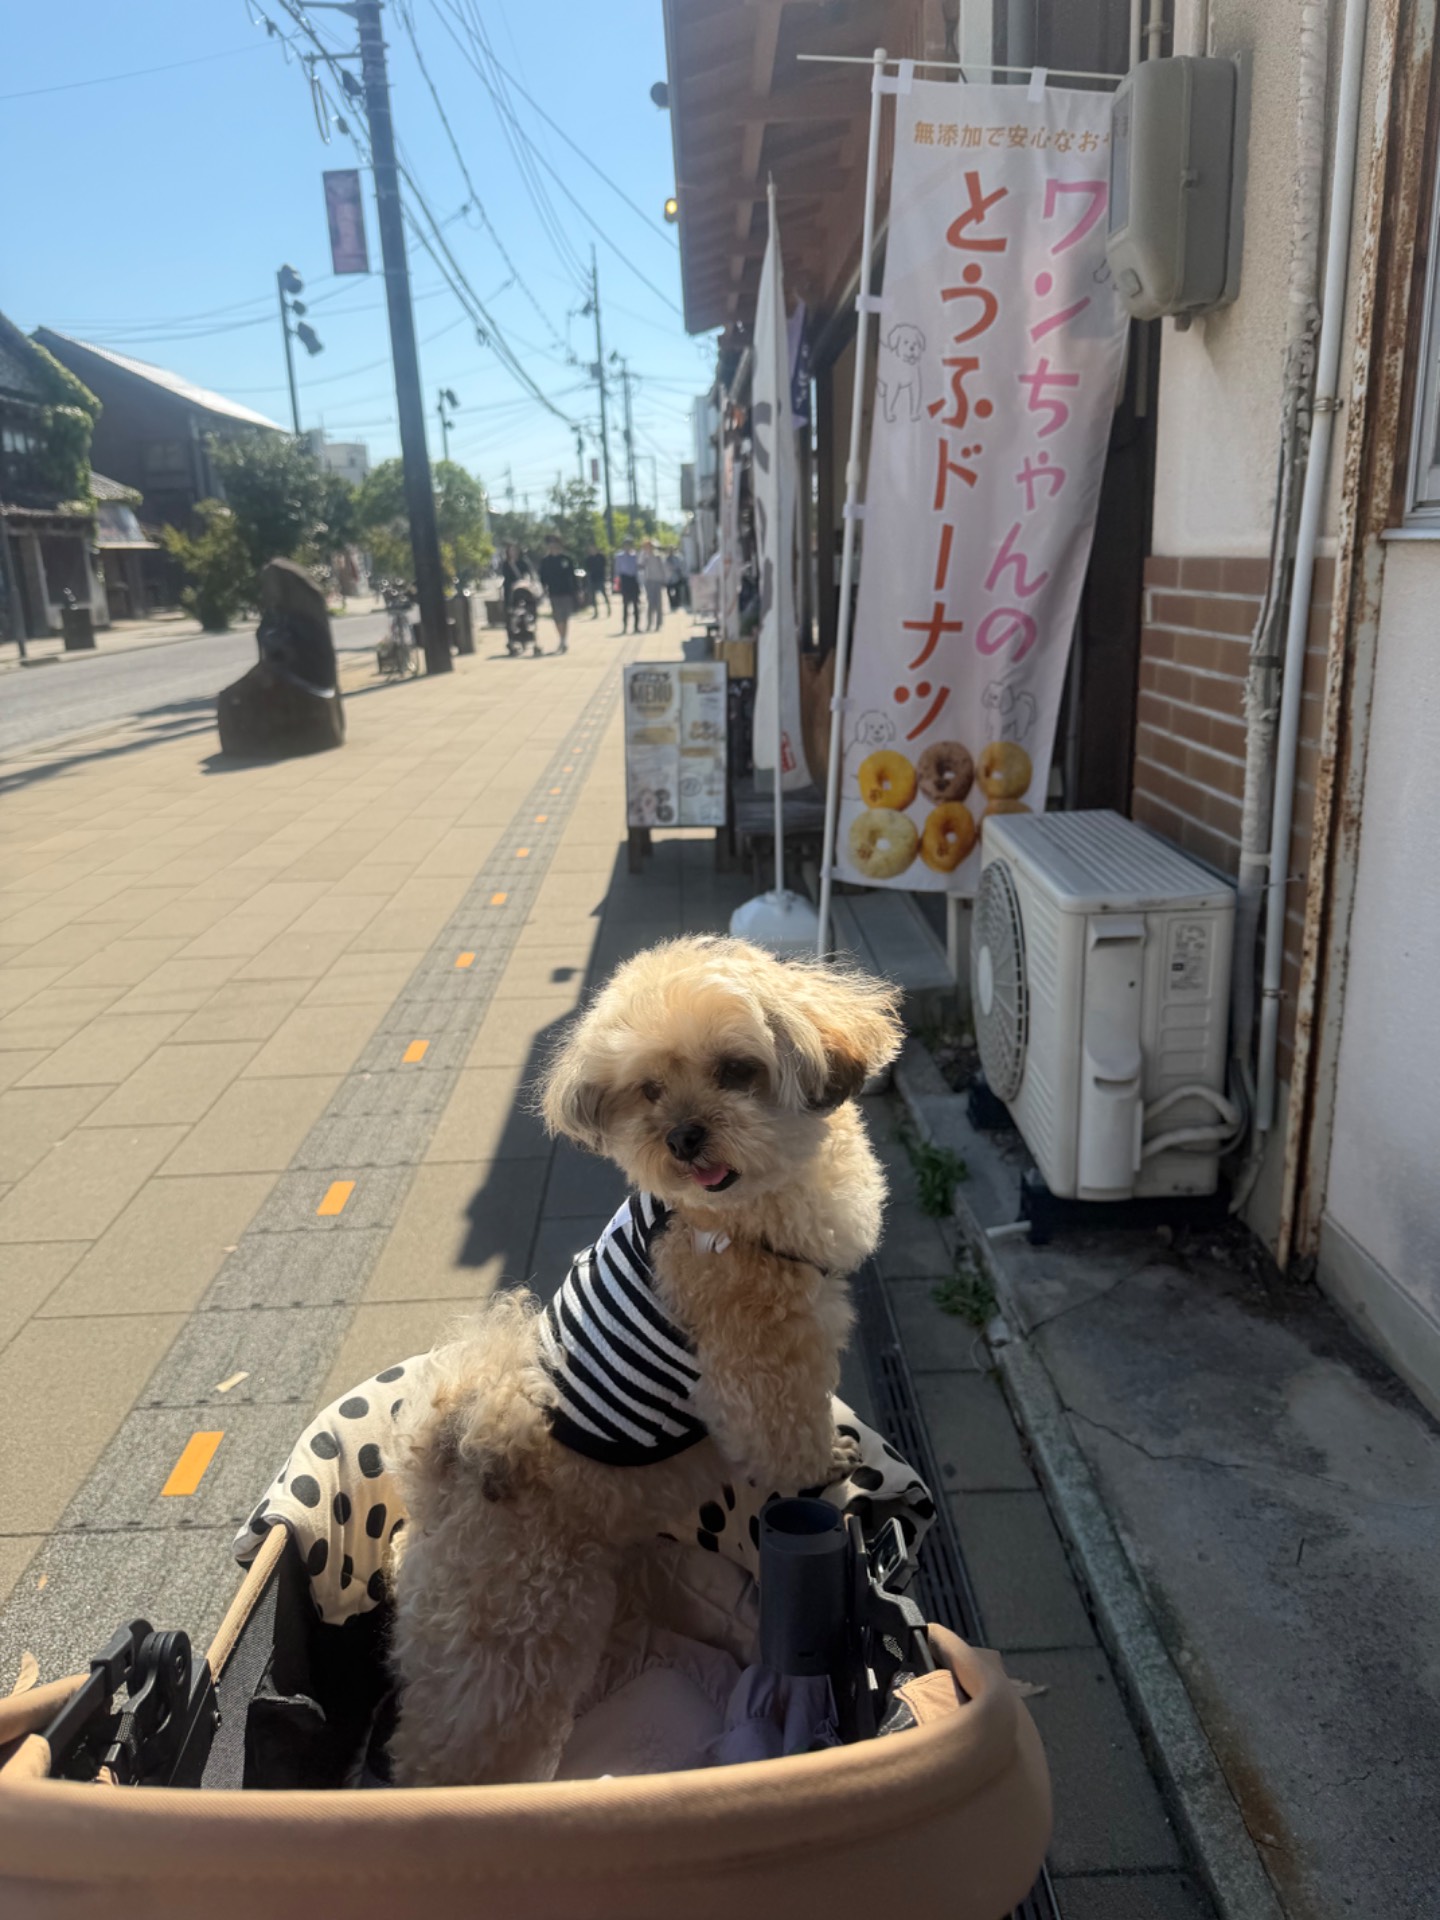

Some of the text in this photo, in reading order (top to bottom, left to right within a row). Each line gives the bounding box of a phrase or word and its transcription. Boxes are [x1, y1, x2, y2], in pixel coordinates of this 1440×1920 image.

[894, 171, 1008, 740] とうふドーナツ
[976, 178, 1107, 663] ワンちゃんの
